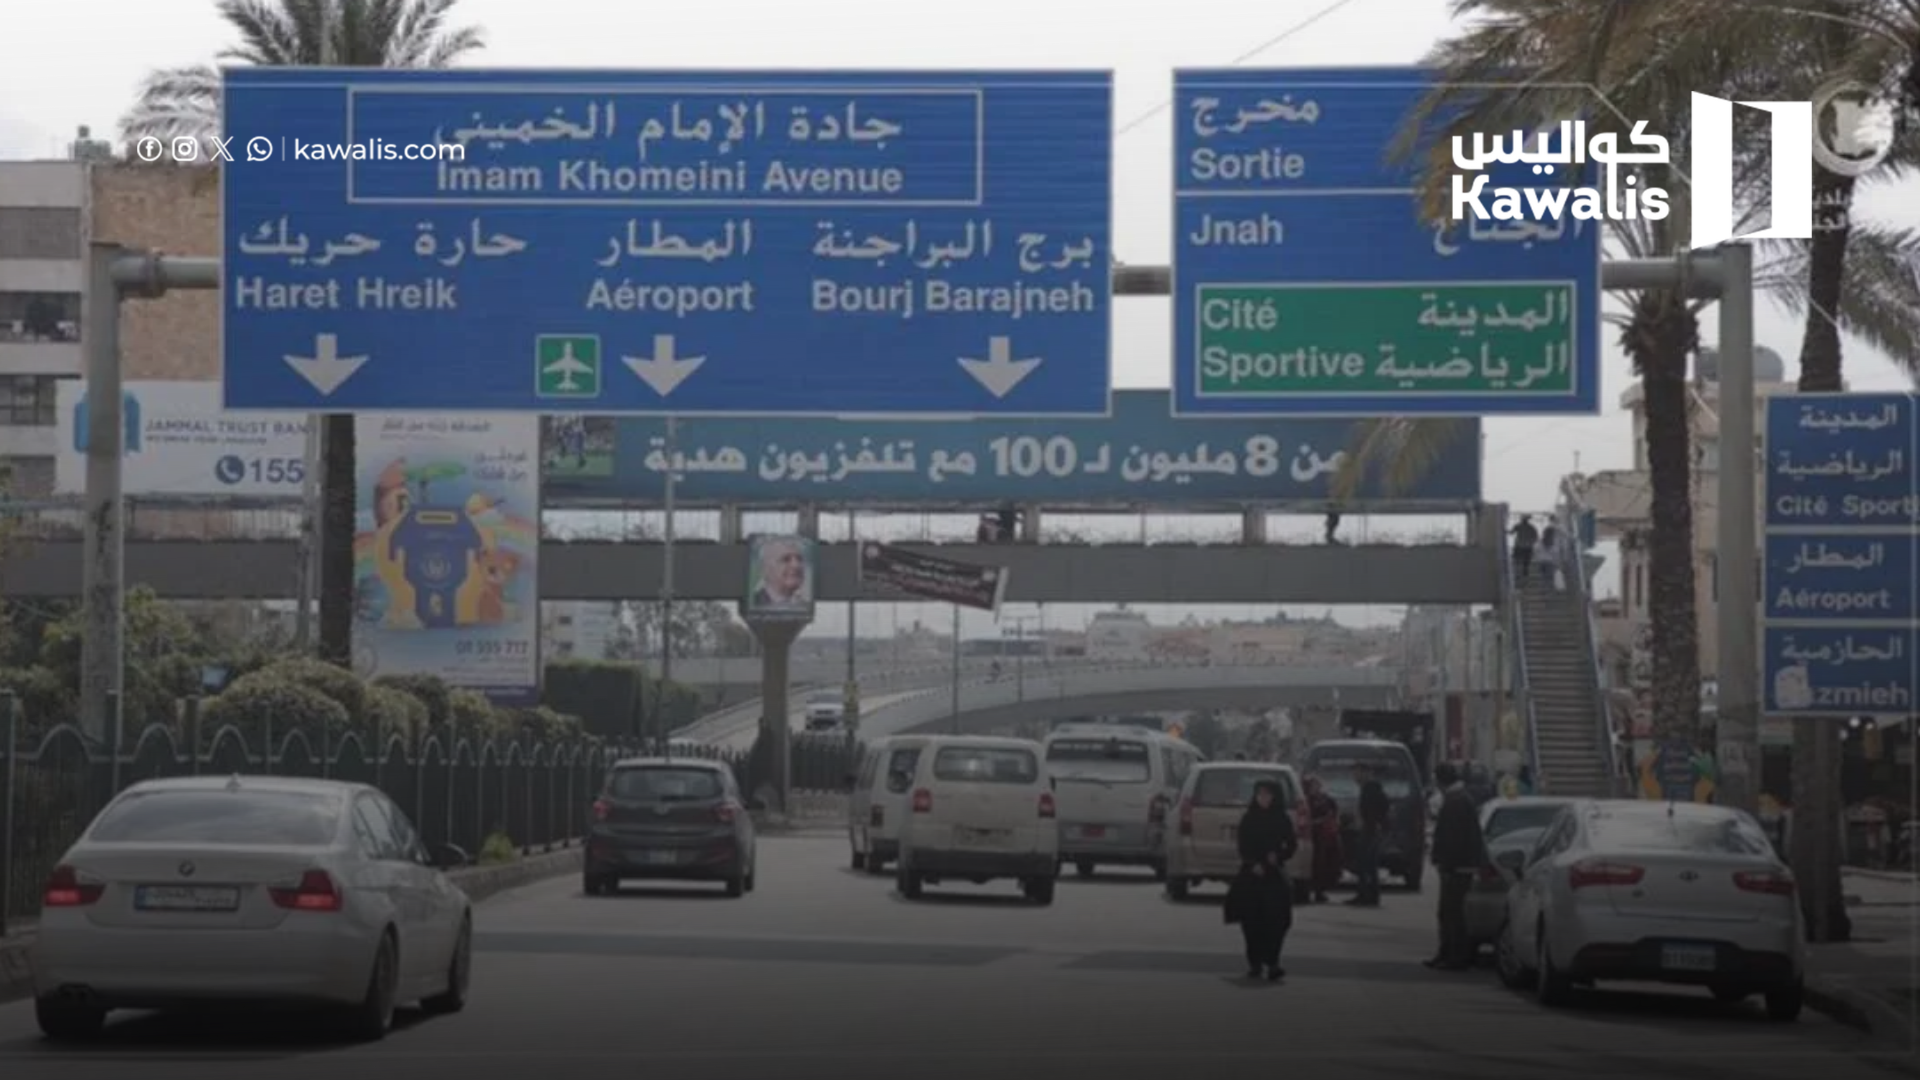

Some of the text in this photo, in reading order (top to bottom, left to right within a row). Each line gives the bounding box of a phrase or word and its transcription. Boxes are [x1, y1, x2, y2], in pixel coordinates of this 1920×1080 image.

[433, 101, 903, 161] جادة الإمام الخميني
[1191, 94, 1319, 136] مخرج
[438, 160, 903, 192] Imam Khomeini Avenue
[1191, 147, 1305, 179] Sortie
[239, 216, 527, 266] حارة حريك
[598, 218, 752, 267] المطار
[813, 219, 1095, 272] برج البراجنة
[1190, 213, 1283, 246] Jnah
[236, 276, 457, 309] Haret Hreik
[586, 279, 754, 318] Aéroport
[812, 280, 1094, 319] Bourj Barajneh
[1202, 297, 1279, 330] Cité
[1417, 289, 1568, 336] المدينة
[1202, 346, 1365, 378] Sportive
[1374, 341, 1568, 388] الرياضية
[217, 420, 268, 434] TRUST
[1799, 403, 1898, 435] المدينة
[644, 437, 747, 482] هدية
[758, 436, 916, 482] تلفزيون
[928, 448, 977, 482] مع
[989, 435, 1077, 477] 100
[1121, 443, 1237, 484] مليون
[1244, 434, 1279, 476] 8
[1290, 445, 1346, 482] من
[1777, 449, 1903, 481] الرياضية
[1776, 494, 1829, 516] Cité
[1786, 543, 1884, 573] المطار
[1775, 585, 1890, 611] Aéroport
[1781, 634, 1904, 665] الحازمية
[1800, 680, 1909, 706] zmieh
